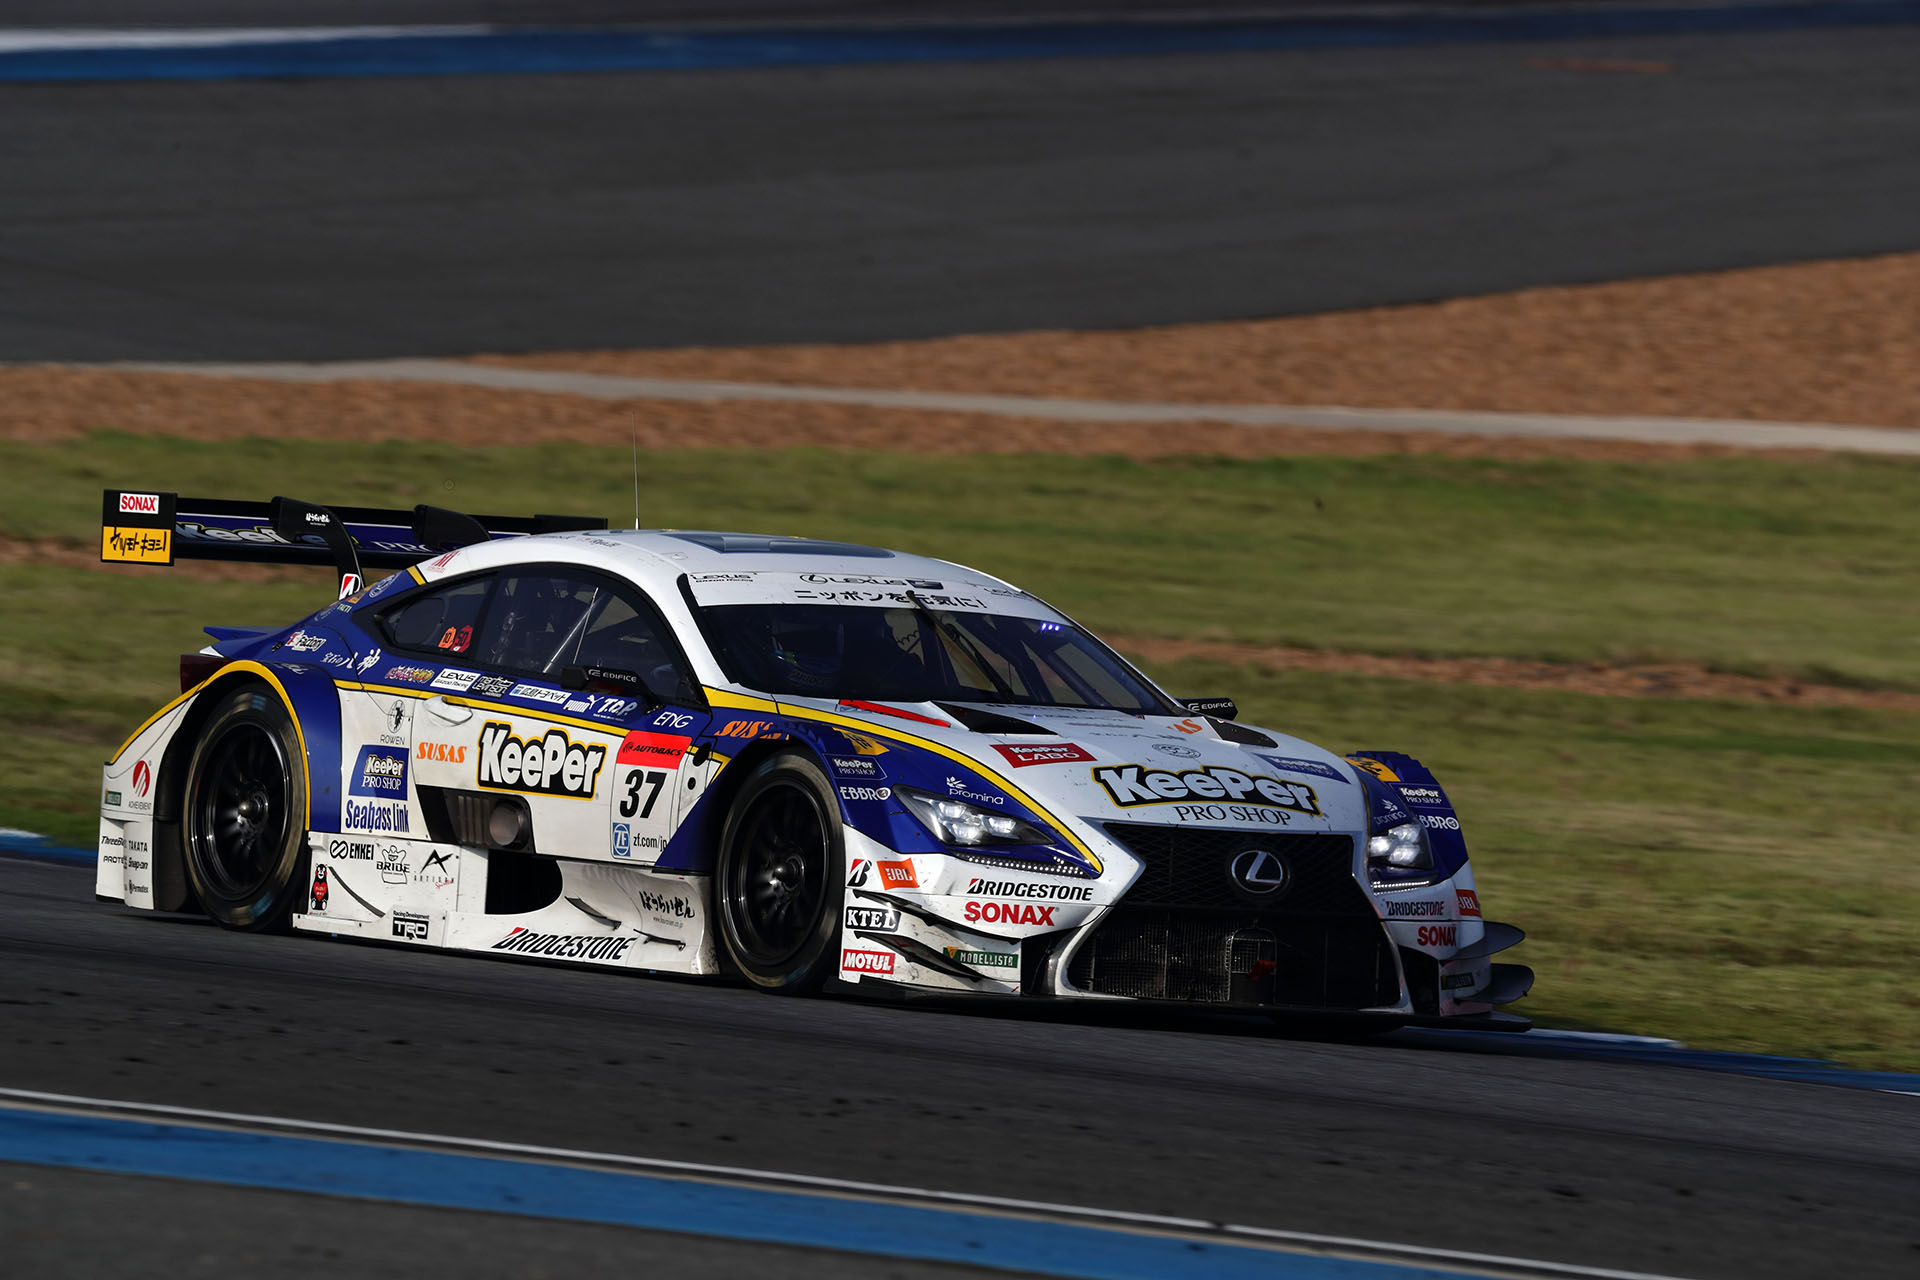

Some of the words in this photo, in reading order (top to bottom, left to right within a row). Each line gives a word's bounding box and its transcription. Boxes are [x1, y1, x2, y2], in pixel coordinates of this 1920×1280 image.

[121, 495, 156, 512] SONAX
[829, 577, 907, 586] LEXUS
[441, 671, 476, 682] LEXUS
[602, 672, 638, 683] EDIFICE
[521, 687, 567, 703] 広島トヨペット
[1201, 702, 1234, 710] EDIFICE
[653, 711, 694, 729] ENG
[380, 734, 406, 746] ROWEN
[416, 741, 467, 764] SUSAS
[633, 745, 683, 757] AUTOBACS
[1008, 746, 1069, 754] KeePer
[1017, 752, 1080, 762] LABO
[366, 755, 404, 776] KeePer
[480, 726, 604, 793] KeePer
[833, 758, 874, 769] KeePer
[838, 767, 855, 775] PRO
[856, 768, 876, 776] SHOP
[361, 776, 382, 789] PRO
[383, 777, 402, 790] SHOP
[1100, 766, 1314, 811] KeePer
[619, 768, 668, 819] 37
[840, 786, 891, 800] EBBRO
[949, 788, 1004, 805] promina
[1400, 787, 1439, 798] KeePer
[345, 800, 391, 831] Seabass
[393, 803, 410, 833] Link
[1174, 806, 1227, 822] PRO
[1233, 806, 1291, 826] SHOP
[1417, 815, 1460, 830] BBRO
[128, 840, 148, 852] TAKATA
[614, 830, 629, 848] ZF
[350, 843, 375, 860] ENKEI
[376, 861, 411, 874] BRIDE
[886, 867, 913, 882] JBL
[967, 878, 1094, 901] BRIDGESTONE
[1385, 901, 1445, 916] BRIDGESTONE
[1459, 896, 1479, 911] JBL
[847, 908, 898, 929] KTEL
[964, 901, 1055, 927] SONAX
[394, 920, 428, 939] TRD
[1417, 925, 1457, 947] SONAX
[491, 927, 637, 960] BRIDGESTONE
[843, 952, 893, 971] MOTUL
[959, 951, 1014, 967] MODELLISTA
